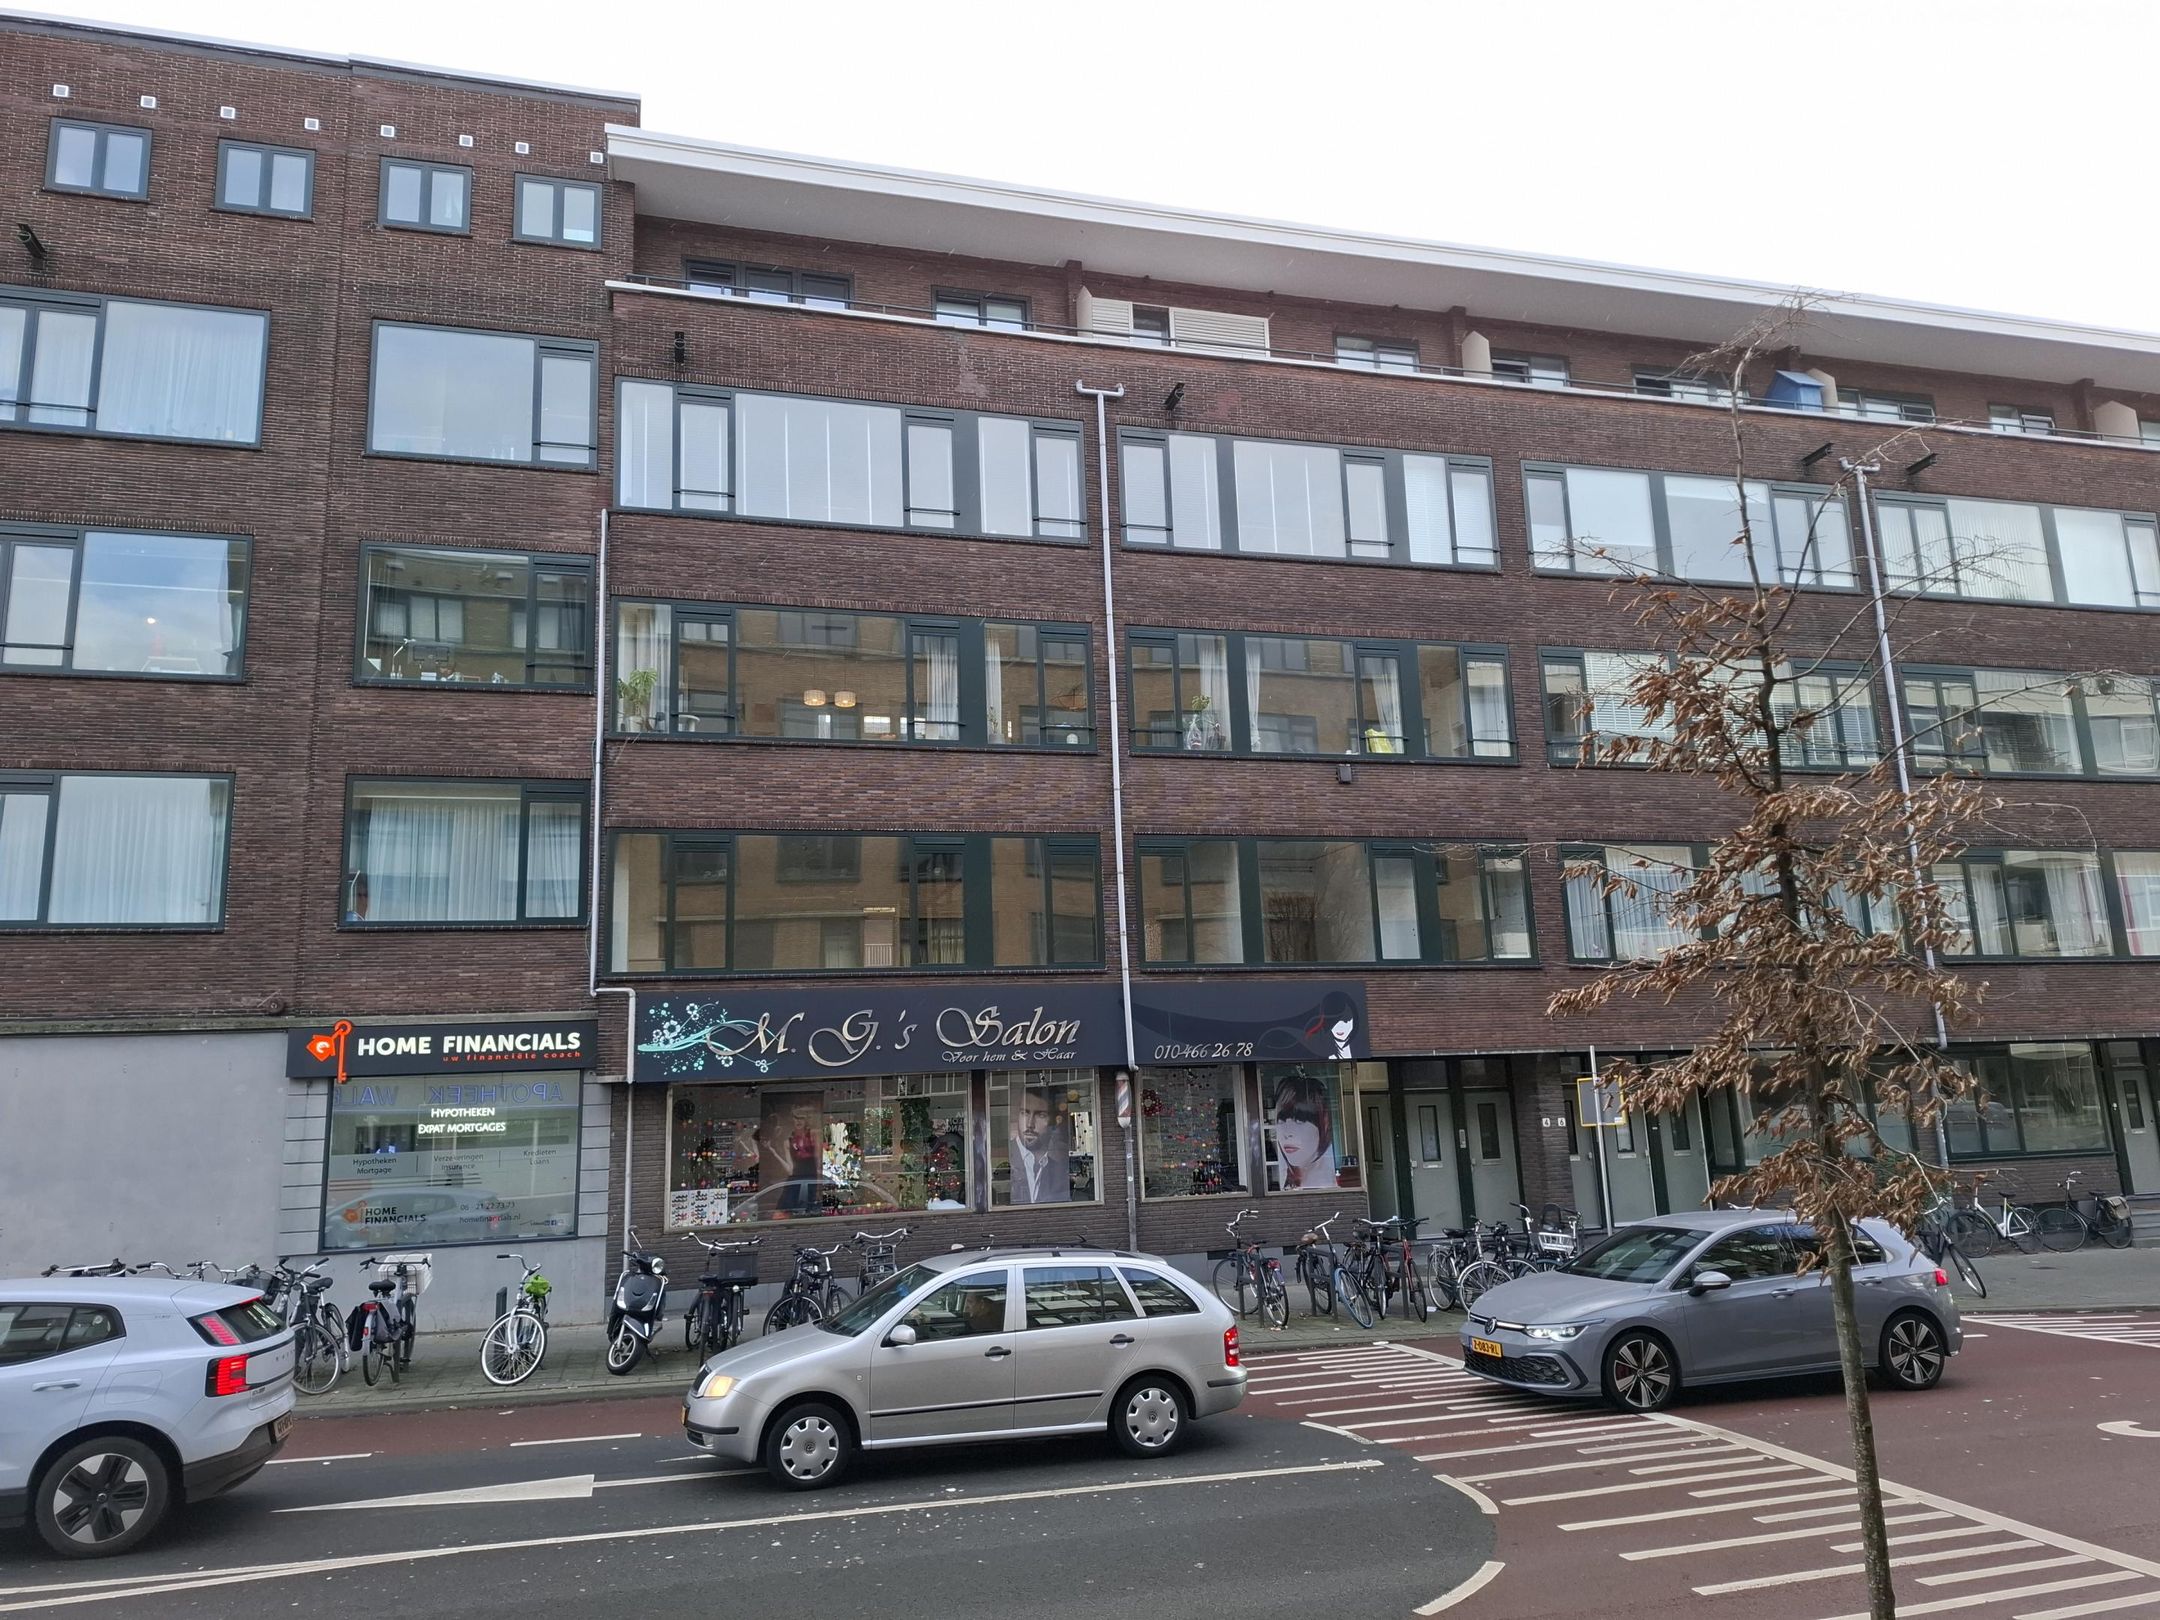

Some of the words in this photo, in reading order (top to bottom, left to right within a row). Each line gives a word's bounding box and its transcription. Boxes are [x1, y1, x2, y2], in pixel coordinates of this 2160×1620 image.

[707, 1012, 805, 1056] M.
[936, 1006, 1081, 1048] Salon
[358, 1036, 431, 1056] HOME
[443, 1032, 581, 1054] FINANCIALS
[1212, 1042, 1234, 1058] 26
[1236, 1042, 1254, 1057] 78
[544, 1051, 581, 1059] coach
[942, 1050, 979, 1063] Voor
[982, 1051, 1006, 1062] hem
[1011, 1049, 1029, 1061] &
[1033, 1048, 1077, 1061] Haar
[430, 1107, 496, 1119] HYPOTHEKEN
[418, 1123, 445, 1134] EXPAT
[447, 1121, 507, 1133] MORTGAGES
[353, 1157, 397, 1167] Hypotheken
[356, 1167, 392, 1175] Mortgage
[365, 1206, 397, 1216] HOME
[365, 1214, 427, 1225] FINANCIALS
